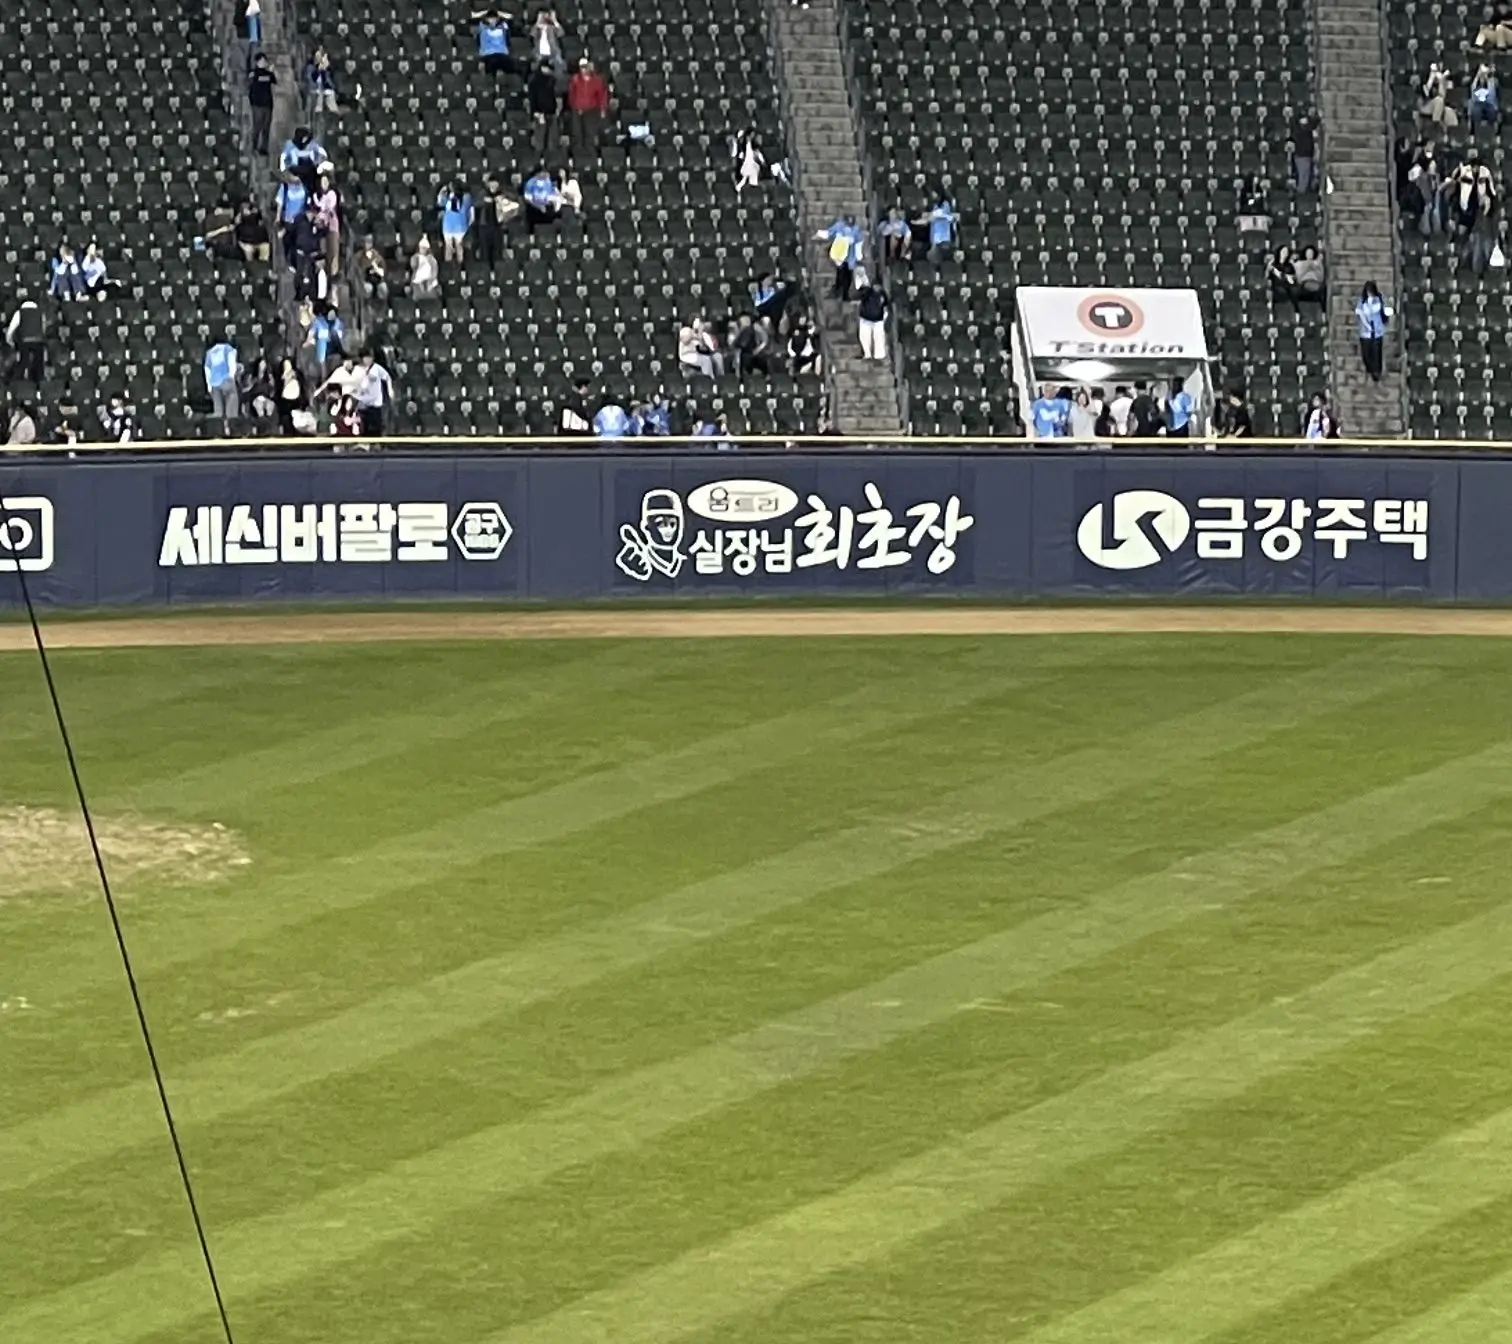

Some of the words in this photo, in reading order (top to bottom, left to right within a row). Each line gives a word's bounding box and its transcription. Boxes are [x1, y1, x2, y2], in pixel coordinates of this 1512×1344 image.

[158, 502, 448, 566] 세신버팔로
[689, 528, 792, 576] 실장님
[795, 482, 974, 574] 회초장
[1195, 498, 1429, 561] 금강주택
